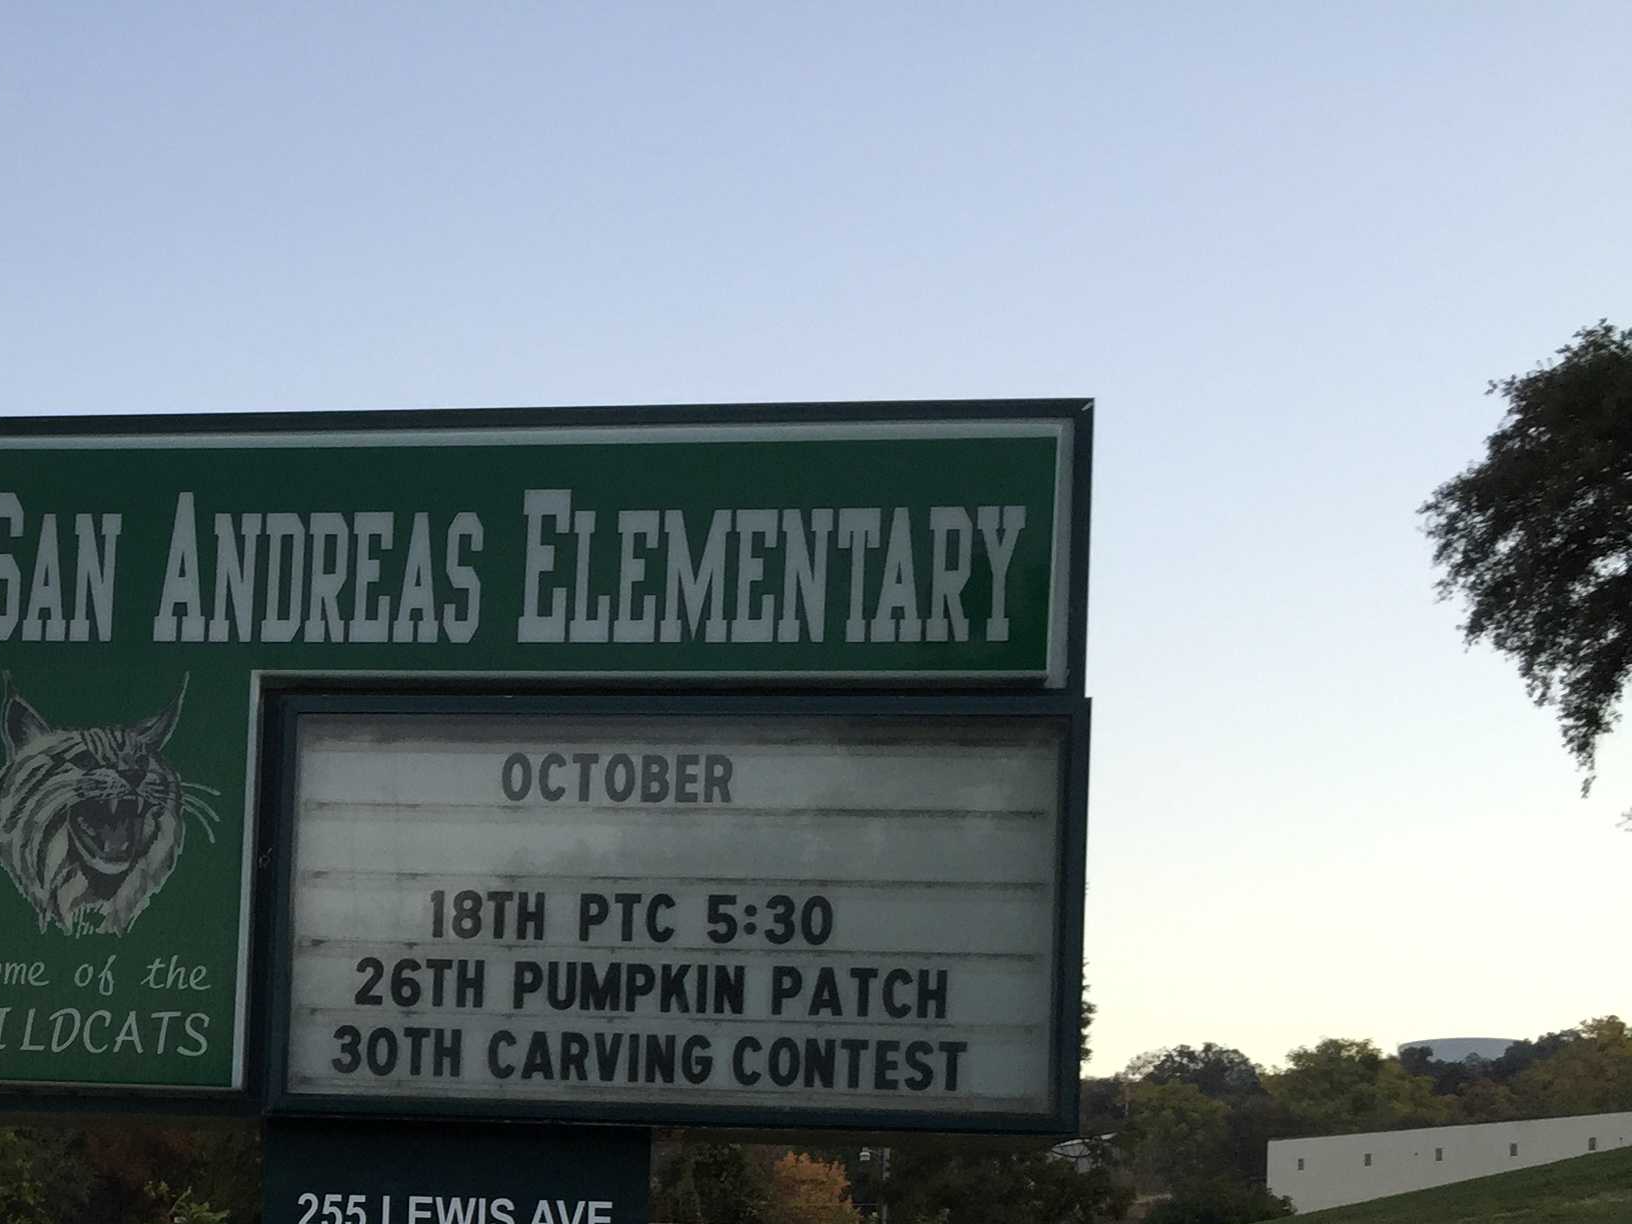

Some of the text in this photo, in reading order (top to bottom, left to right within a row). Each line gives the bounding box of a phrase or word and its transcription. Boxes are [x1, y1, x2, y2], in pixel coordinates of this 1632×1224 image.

[152, 491, 485, 643] ANDREAS
[517, 488, 1027, 643] ELEMENTARY
[501, 752, 734, 803] OCTOBER
[430, 889, 834, 946] 18TH PTC 5:30
[73, 954, 117, 996] of
[140, 954, 212, 991] the
[354, 956, 949, 1020] 26TH PUMPKIN PATCH
[331, 1024, 968, 1093] 30TH CARVING CONTEST
